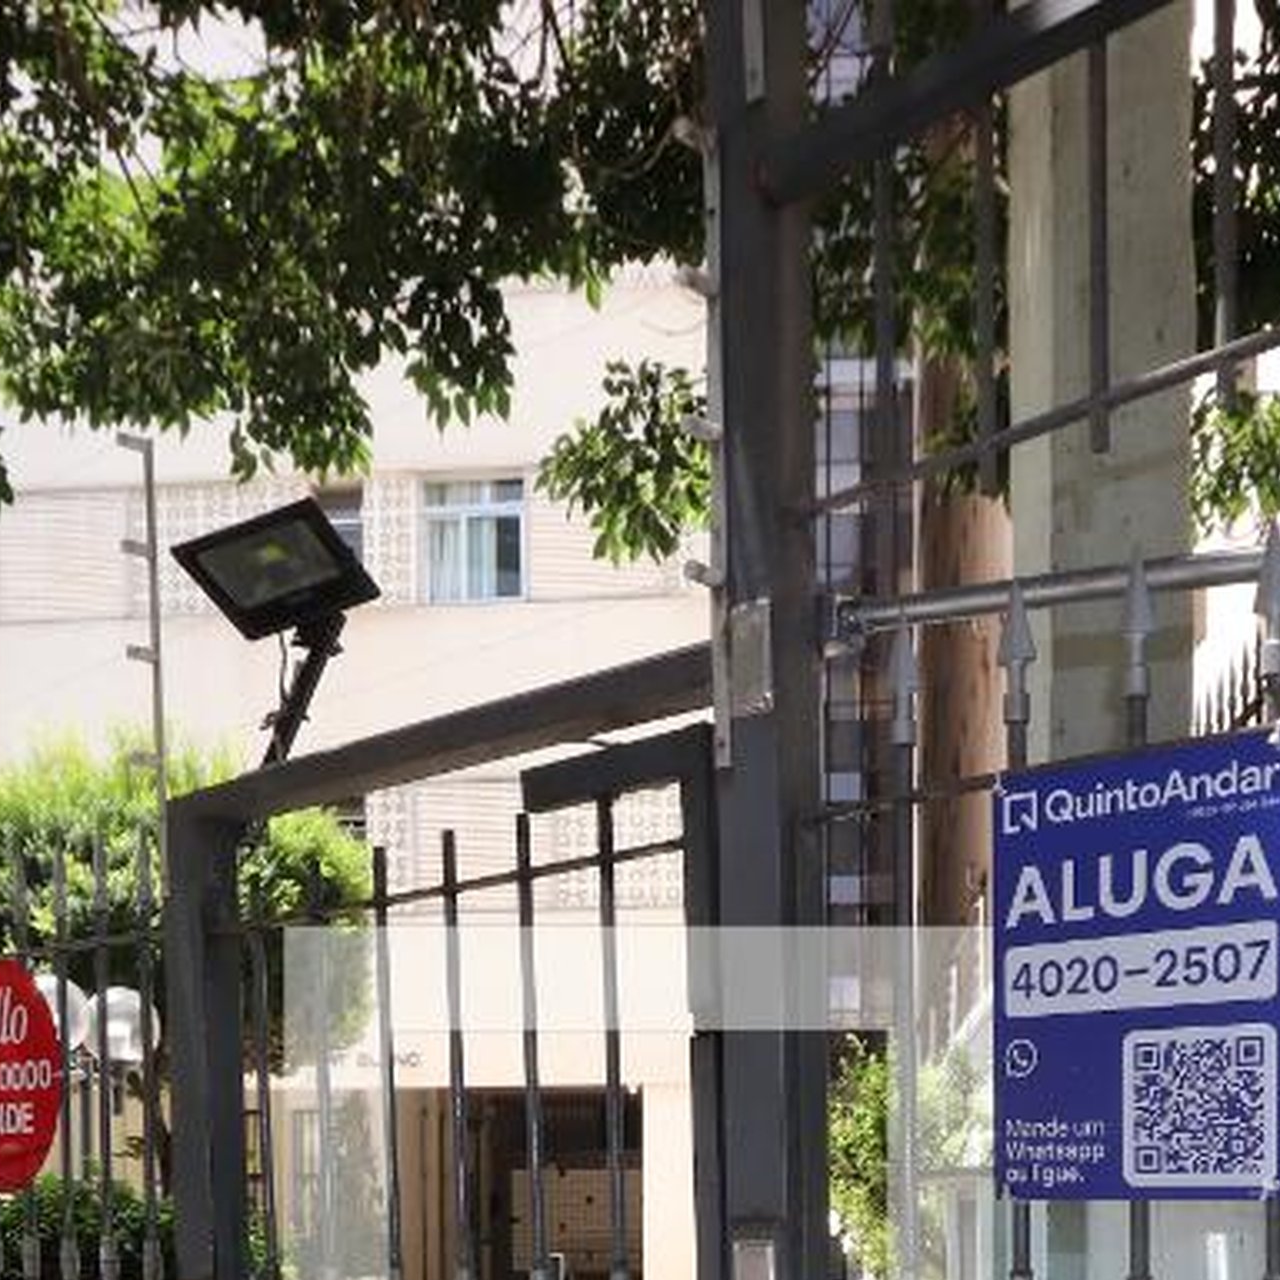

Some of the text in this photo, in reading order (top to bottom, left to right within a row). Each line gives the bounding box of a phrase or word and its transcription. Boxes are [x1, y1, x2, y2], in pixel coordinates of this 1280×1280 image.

[1044, 760, 1280, 823] QuintoAndar
[1006, 833, 1278, 930] ALUGA
[1012, 940, 1272, 999] 4020-2507
